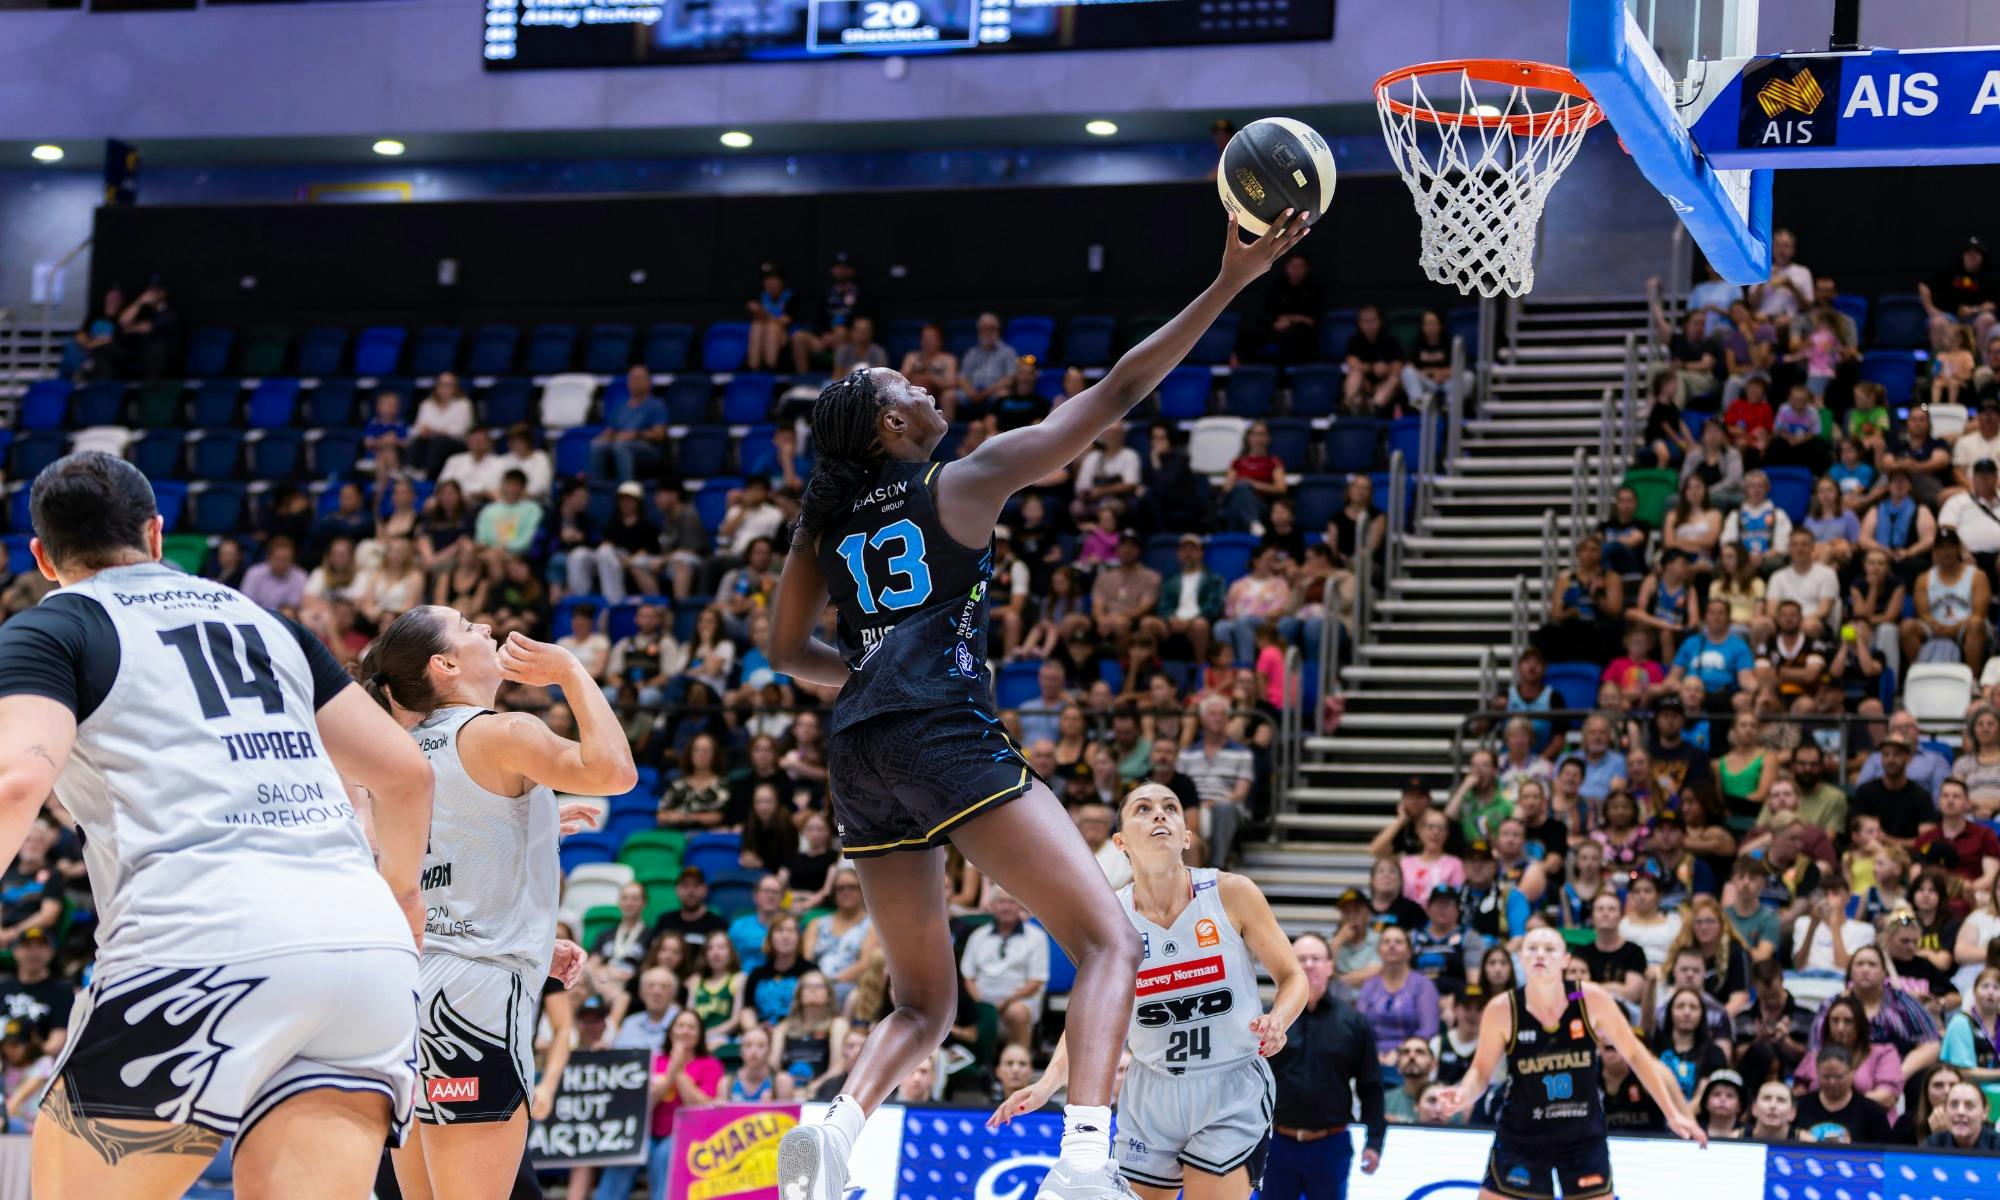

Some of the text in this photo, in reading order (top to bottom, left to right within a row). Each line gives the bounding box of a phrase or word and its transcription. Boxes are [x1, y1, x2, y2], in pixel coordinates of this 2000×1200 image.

[863, 1, 920, 28] 20
[1842, 72, 1939, 118] AIS
[1762, 120, 1813, 144] AIS
[881, 500, 905, 513] GROUP
[836, 518, 933, 614] 13
[956, 601, 974, 636] SLAVEN
[156, 621, 285, 720] 14
[257, 782, 323, 804] SALON
[225, 802, 354, 828] WAREHOUS
[420, 863, 452, 891] MAN
[427, 905, 449, 921] ON
[1136, 965, 1218, 989] Harvey Norman
[1136, 988, 1234, 1027] SYD
[1166, 1026, 1211, 1062] 24
[563, 1062, 647, 1091] HING
[1517, 1051, 1591, 1075] CAPITALS
[431, 1081, 475, 1098] AAMI
[1542, 1072, 1573, 1101] 10
[556, 1093, 613, 1121] BUT
[529, 1116, 638, 1157] ARDZ!
